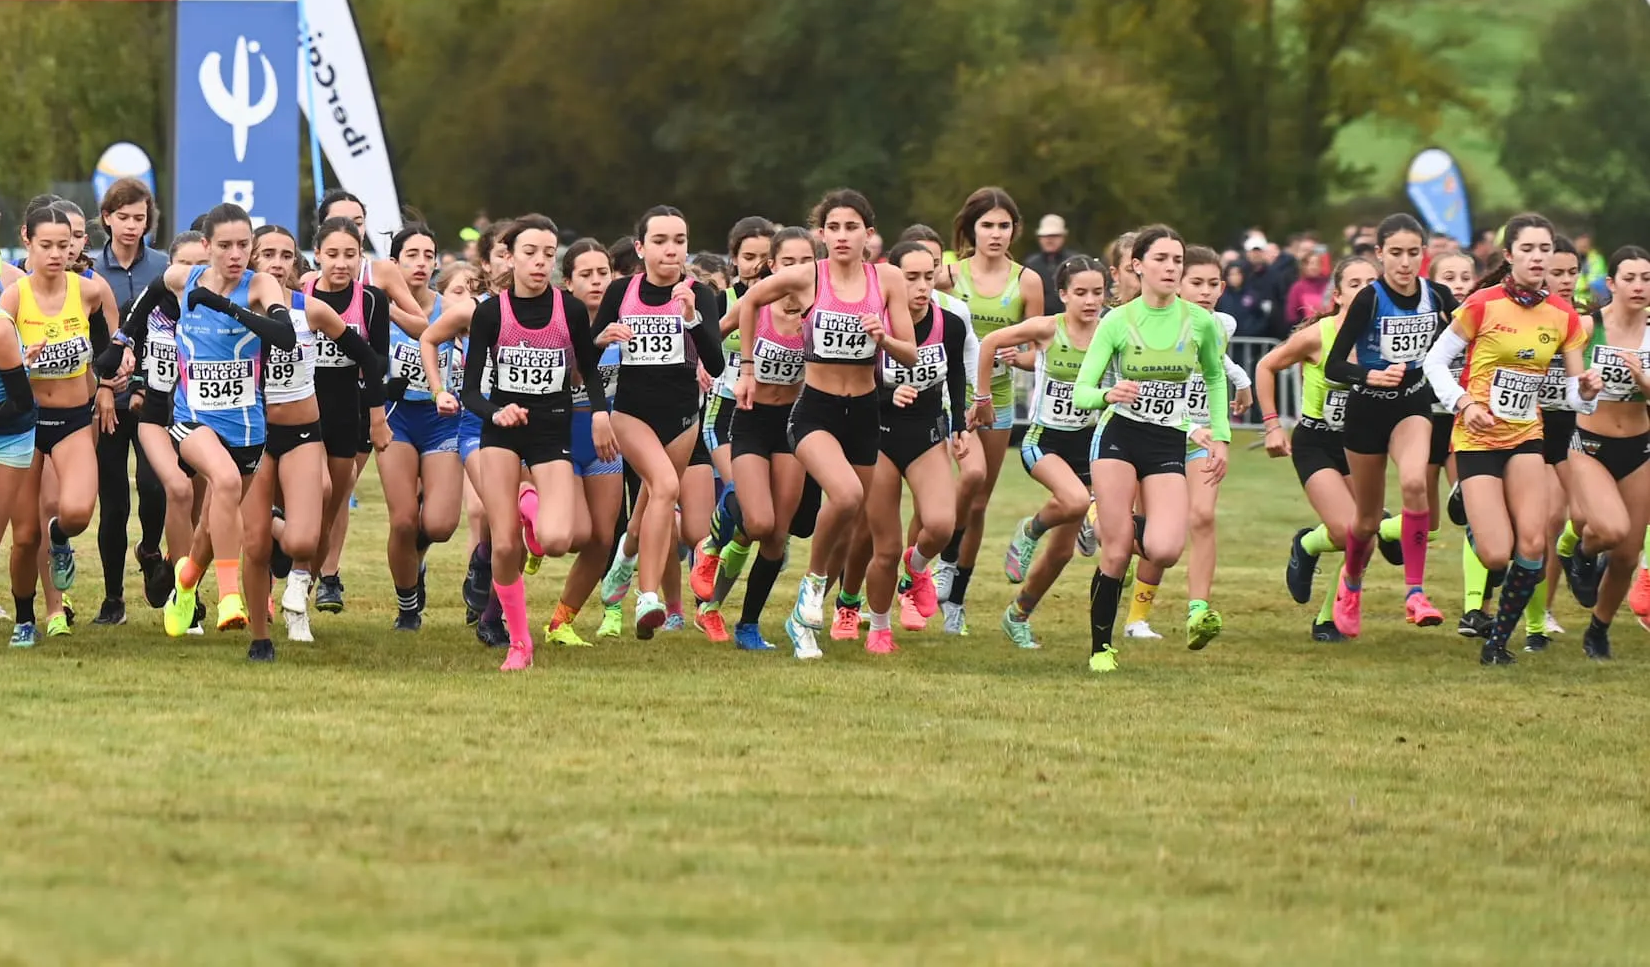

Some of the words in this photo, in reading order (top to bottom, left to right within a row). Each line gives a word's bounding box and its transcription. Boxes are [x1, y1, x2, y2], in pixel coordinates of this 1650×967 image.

[631, 325, 677, 333] URGOS
[819, 320, 865, 333] BURGO
[1387, 323, 1434, 334] BURGOS
[628, 336, 672, 353] 5133
[823, 332, 866, 348] 5144
[1392, 334, 1428, 351] 5313
[35, 345, 84, 363] URGOS
[271, 355, 299, 363] GOS
[503, 349, 560, 359] DIPUTACIÓN
[759, 348, 803, 363] BURGO
[503, 357, 560, 367] BURGOS
[760, 361, 803, 376] 5137
[193, 369, 248, 380] BURGOS
[509, 367, 553, 385] 5134
[895, 366, 937, 383] 5135
[199, 380, 243, 398] 5345
[1141, 386, 1183, 398] URGOS
[1362, 389, 1399, 400] PRO
[1131, 397, 1174, 415] 5150
